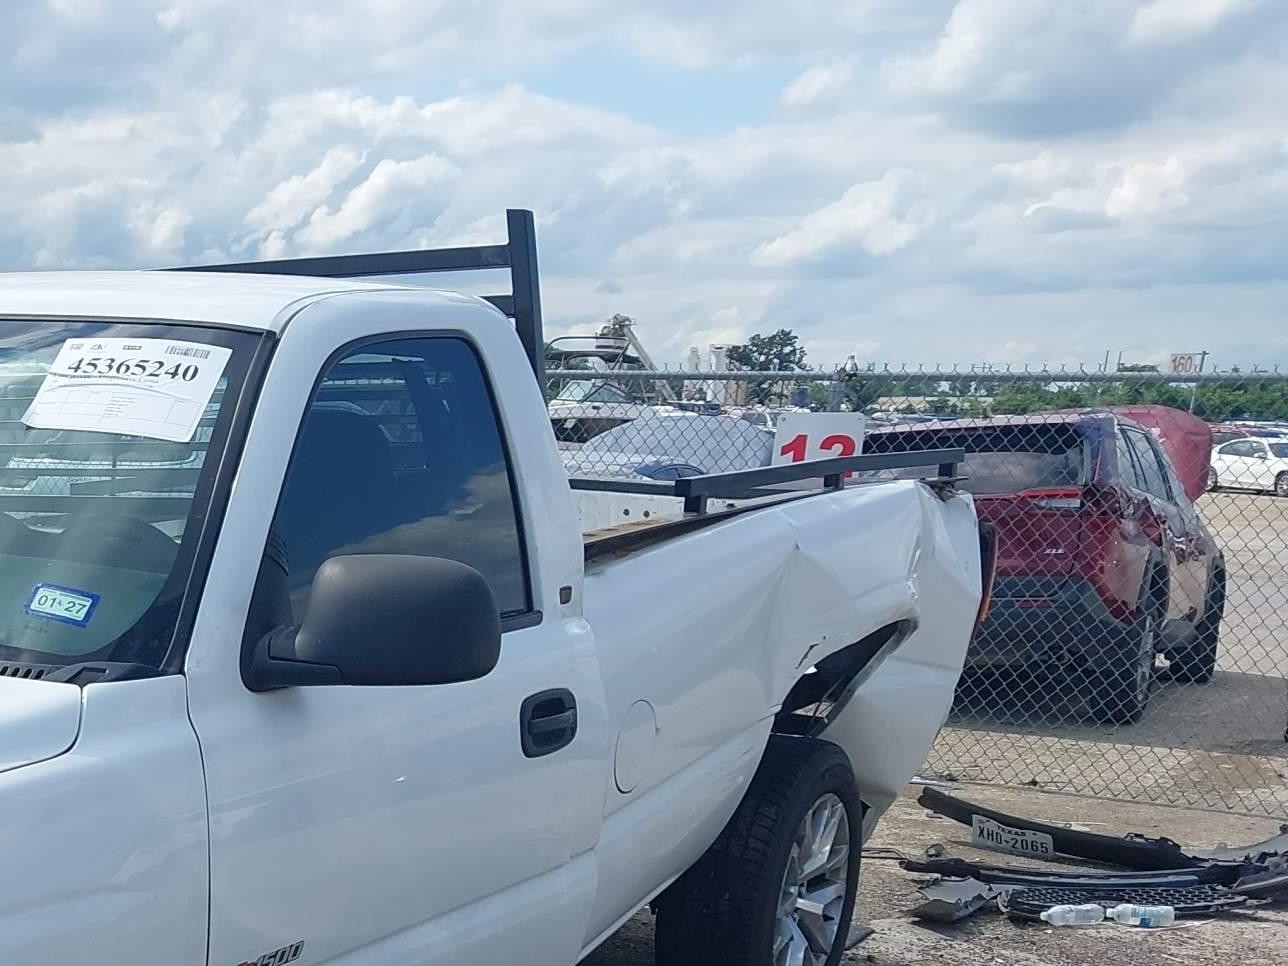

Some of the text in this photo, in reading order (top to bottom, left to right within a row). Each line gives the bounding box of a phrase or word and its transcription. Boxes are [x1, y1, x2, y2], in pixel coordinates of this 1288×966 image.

[67, 357, 199, 382] 45365240
[37, 594, 87, 615] 01 27
[996, 825, 1027, 837] TEXAS
